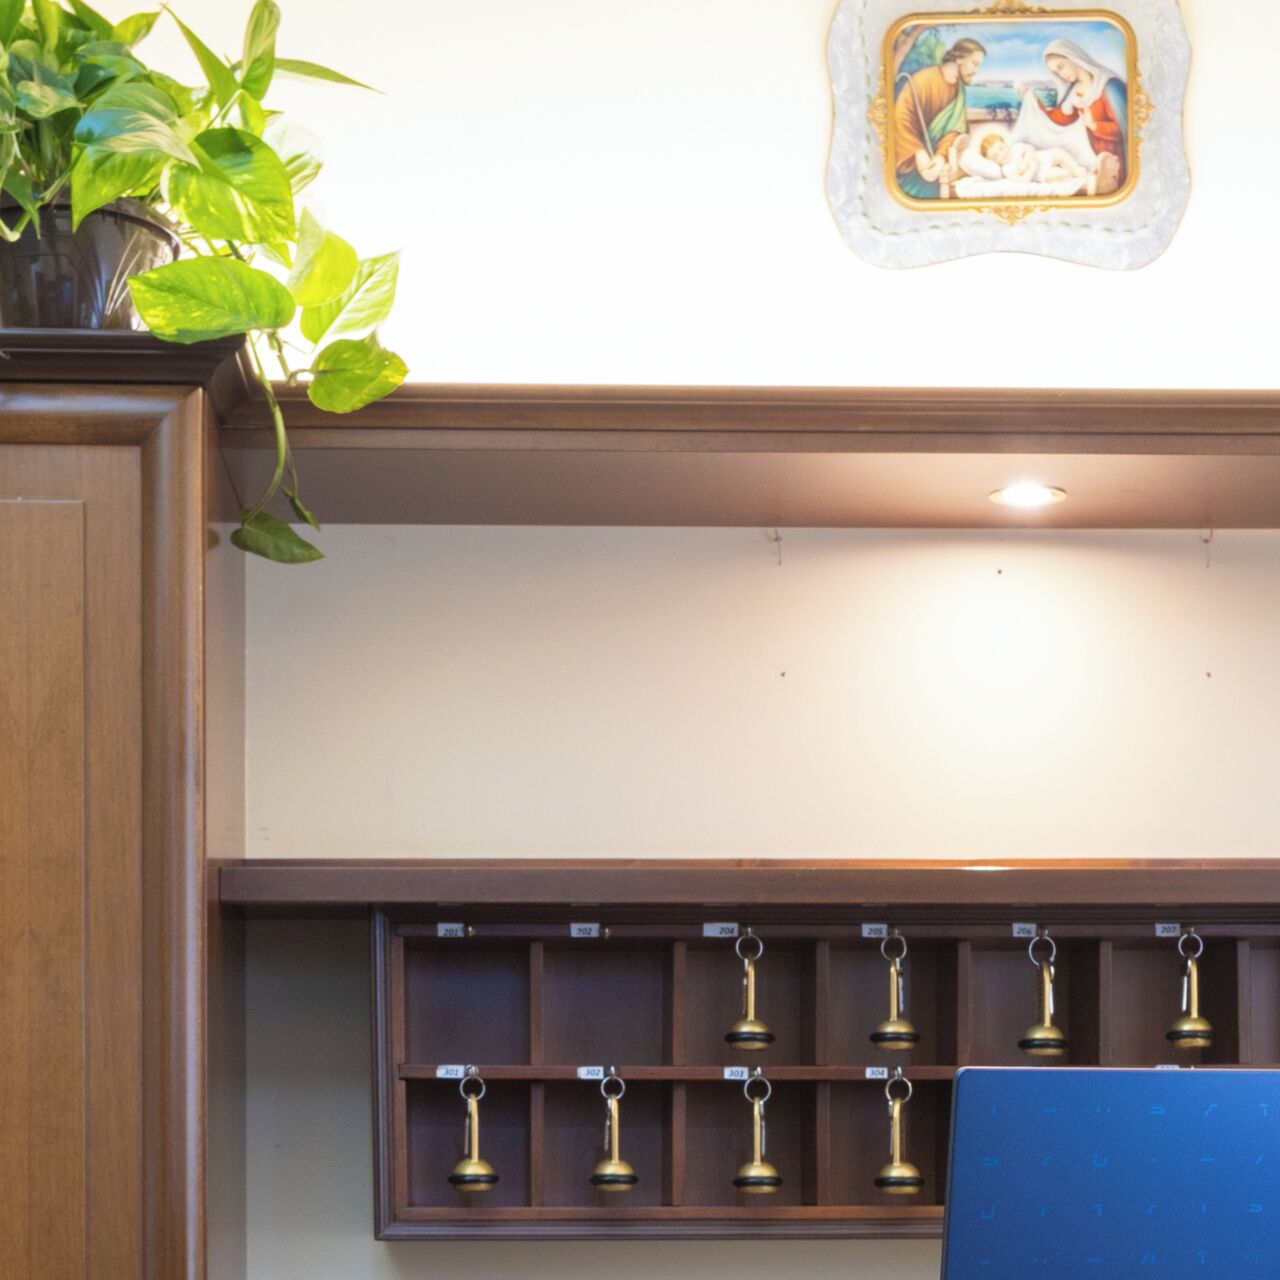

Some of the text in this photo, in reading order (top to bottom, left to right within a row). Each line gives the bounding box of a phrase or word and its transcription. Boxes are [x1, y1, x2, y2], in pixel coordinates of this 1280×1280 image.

[443, 929, 458, 937] 201
[719, 926, 735, 935] 204
[868, 927, 883, 935] 205
[1017, 926, 1032, 935] 206
[443, 1068, 459, 1076] 301
[585, 1069, 601, 1077] 302
[729, 1070, 744, 1078] 303
[870, 1069, 885, 1077] 304
